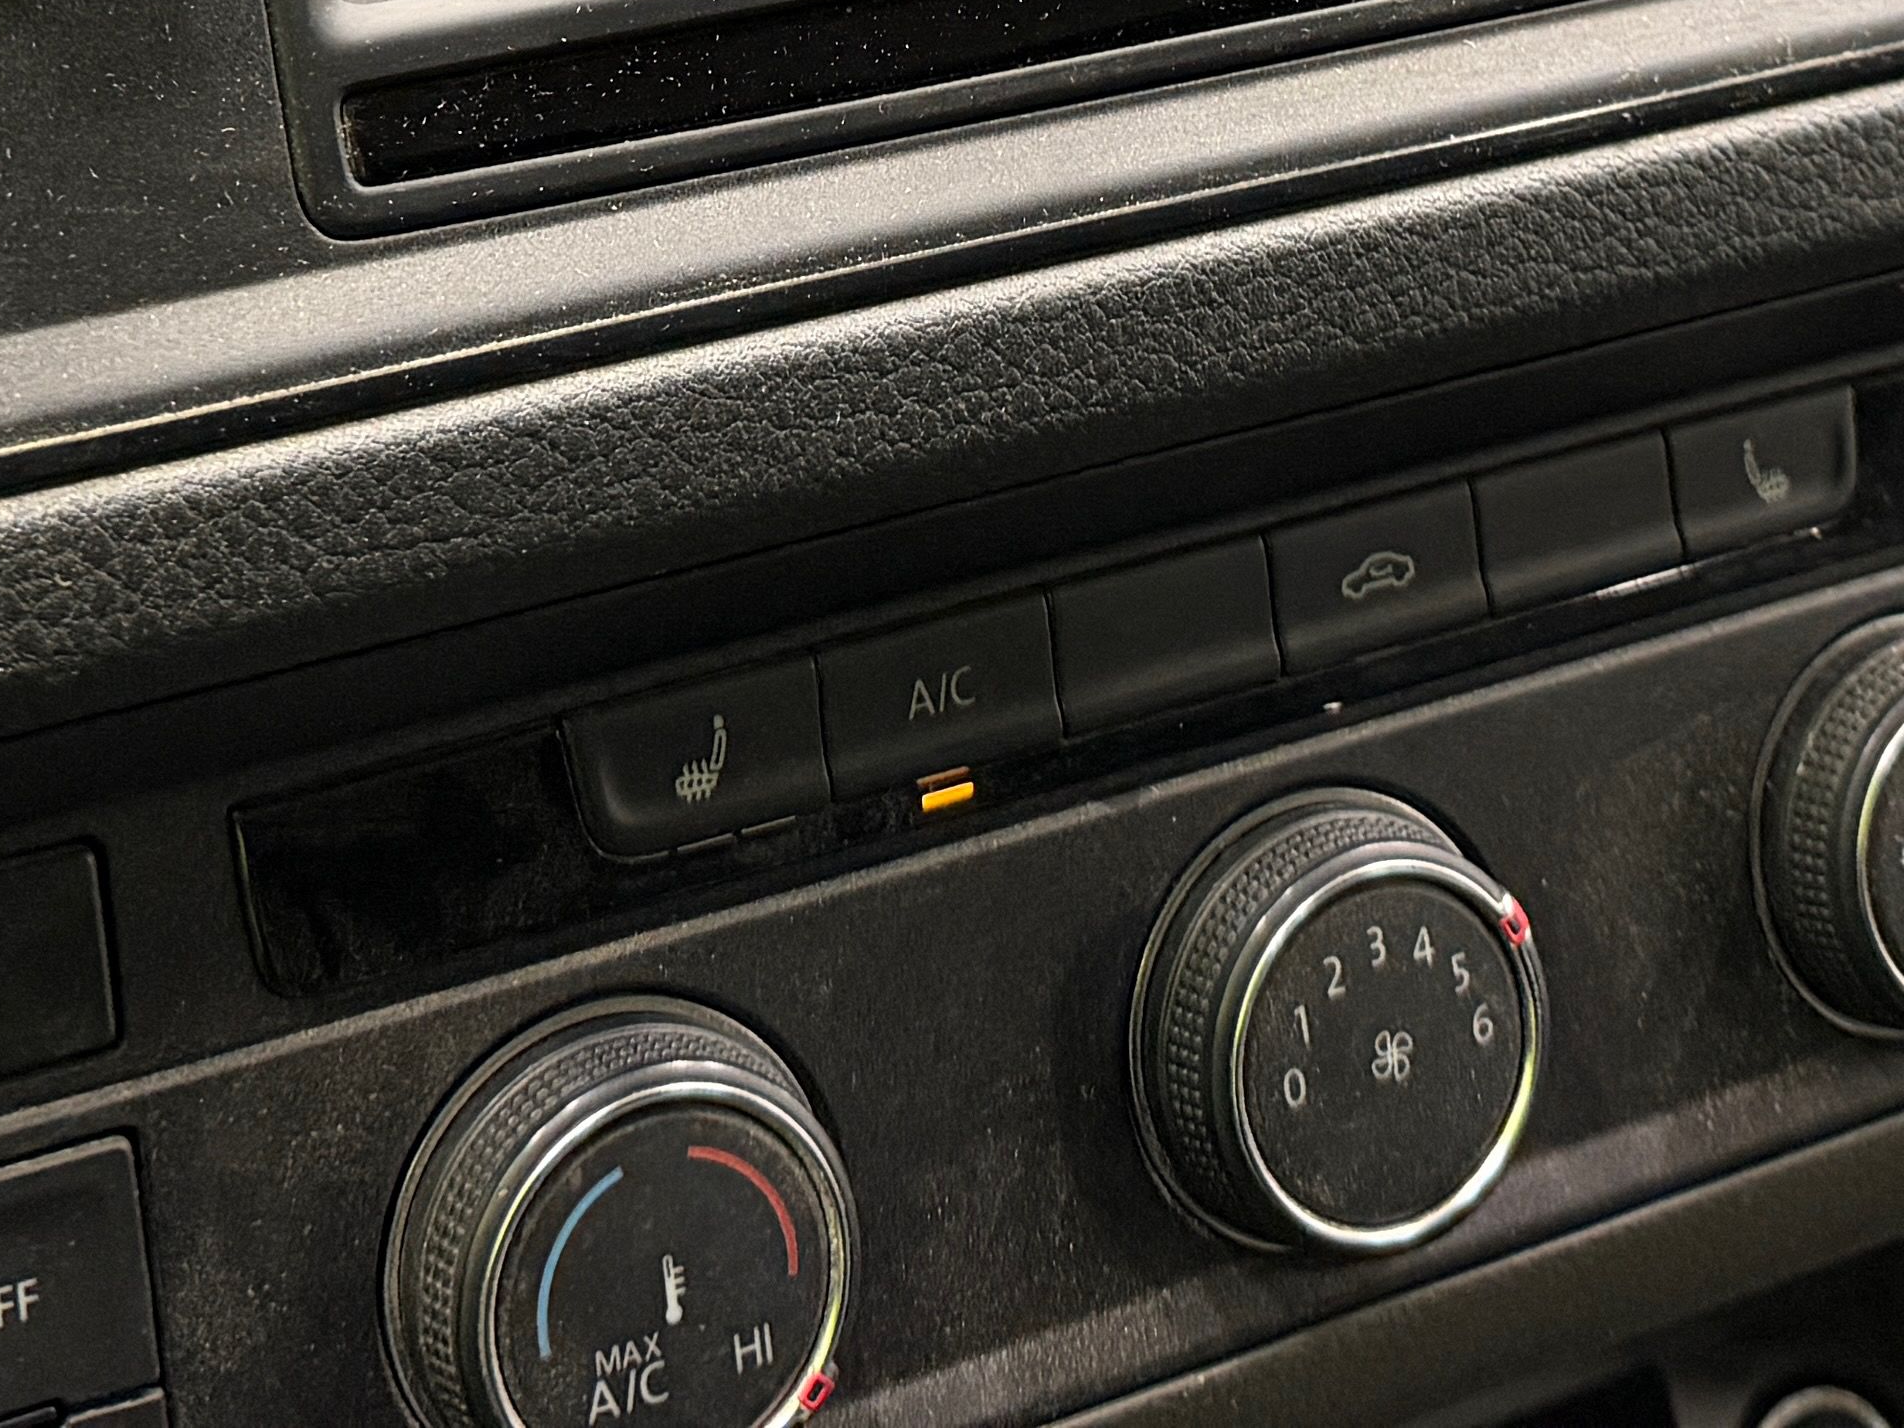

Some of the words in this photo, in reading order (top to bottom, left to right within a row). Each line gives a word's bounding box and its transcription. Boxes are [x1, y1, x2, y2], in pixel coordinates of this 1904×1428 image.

[908, 665, 976, 721] A/C
[1366, 924, 1388, 968] 3
[1412, 925, 1436, 967] 4
[1323, 955, 1346, 1000] 2
[1451, 951, 1471, 995] 5
[1294, 1004, 1311, 1049] 1
[1472, 1002, 1494, 1045] 6
[1283, 1067, 1307, 1109] 0
[595, 1330, 662, 1378] MAX
[733, 1314, 774, 1376] HI
[588, 1359, 670, 1427] A/C
